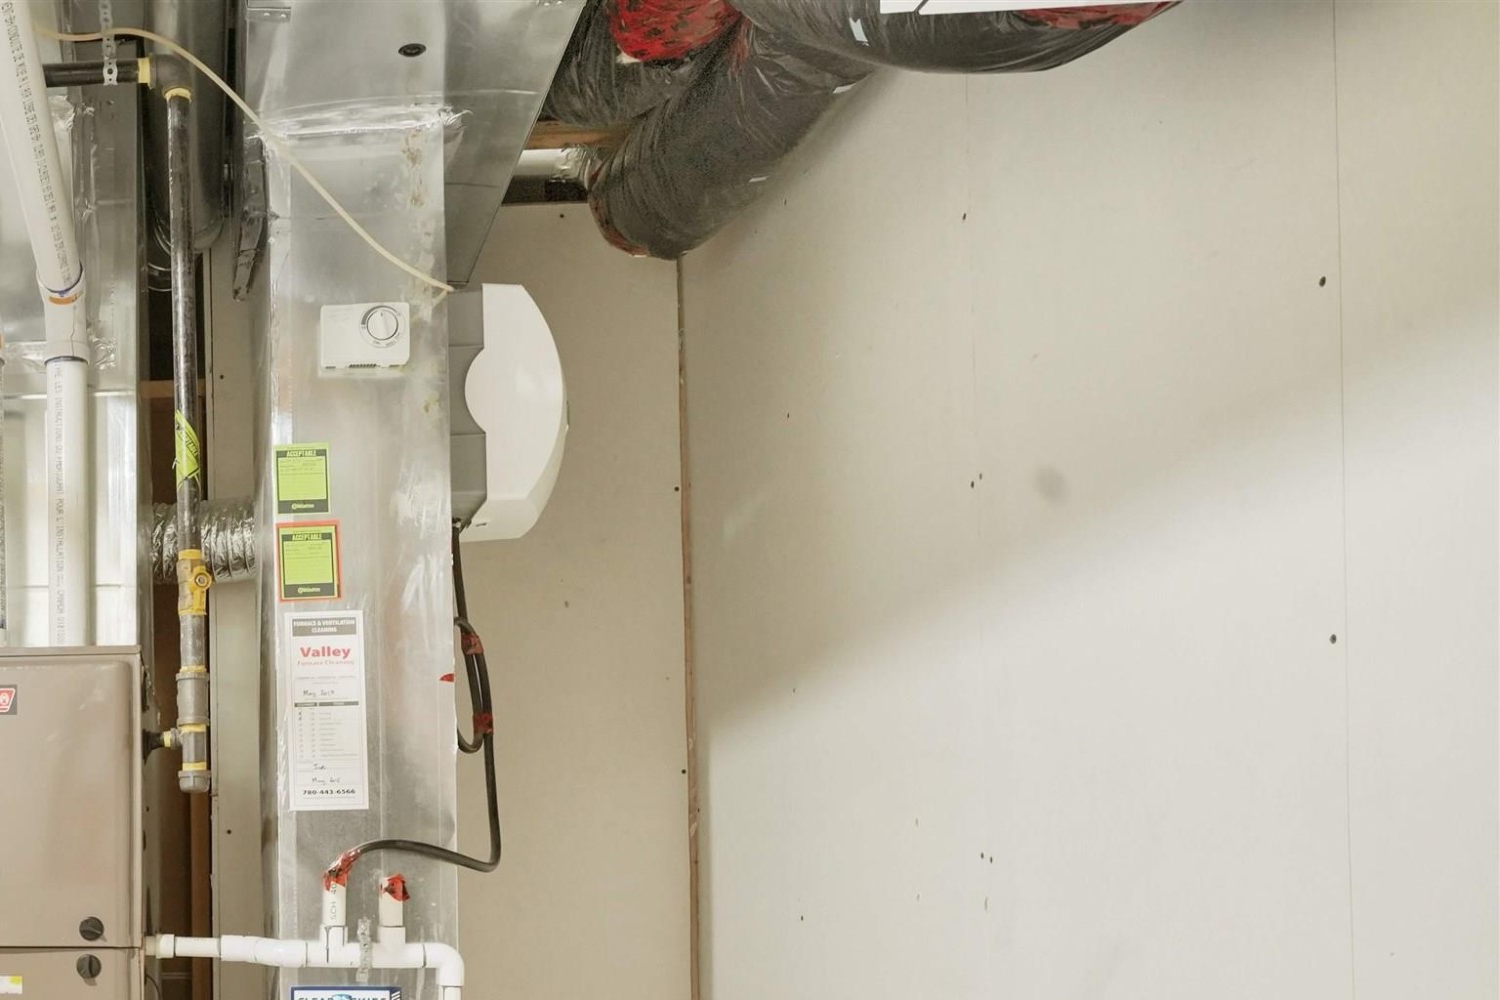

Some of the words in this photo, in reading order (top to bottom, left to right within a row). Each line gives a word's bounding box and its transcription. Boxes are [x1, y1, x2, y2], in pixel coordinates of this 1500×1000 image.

[286, 449, 317, 457] ACCEPTABLE
[292, 533, 322, 541] ACCEPTABLE
[300, 646, 351, 659] Valley
